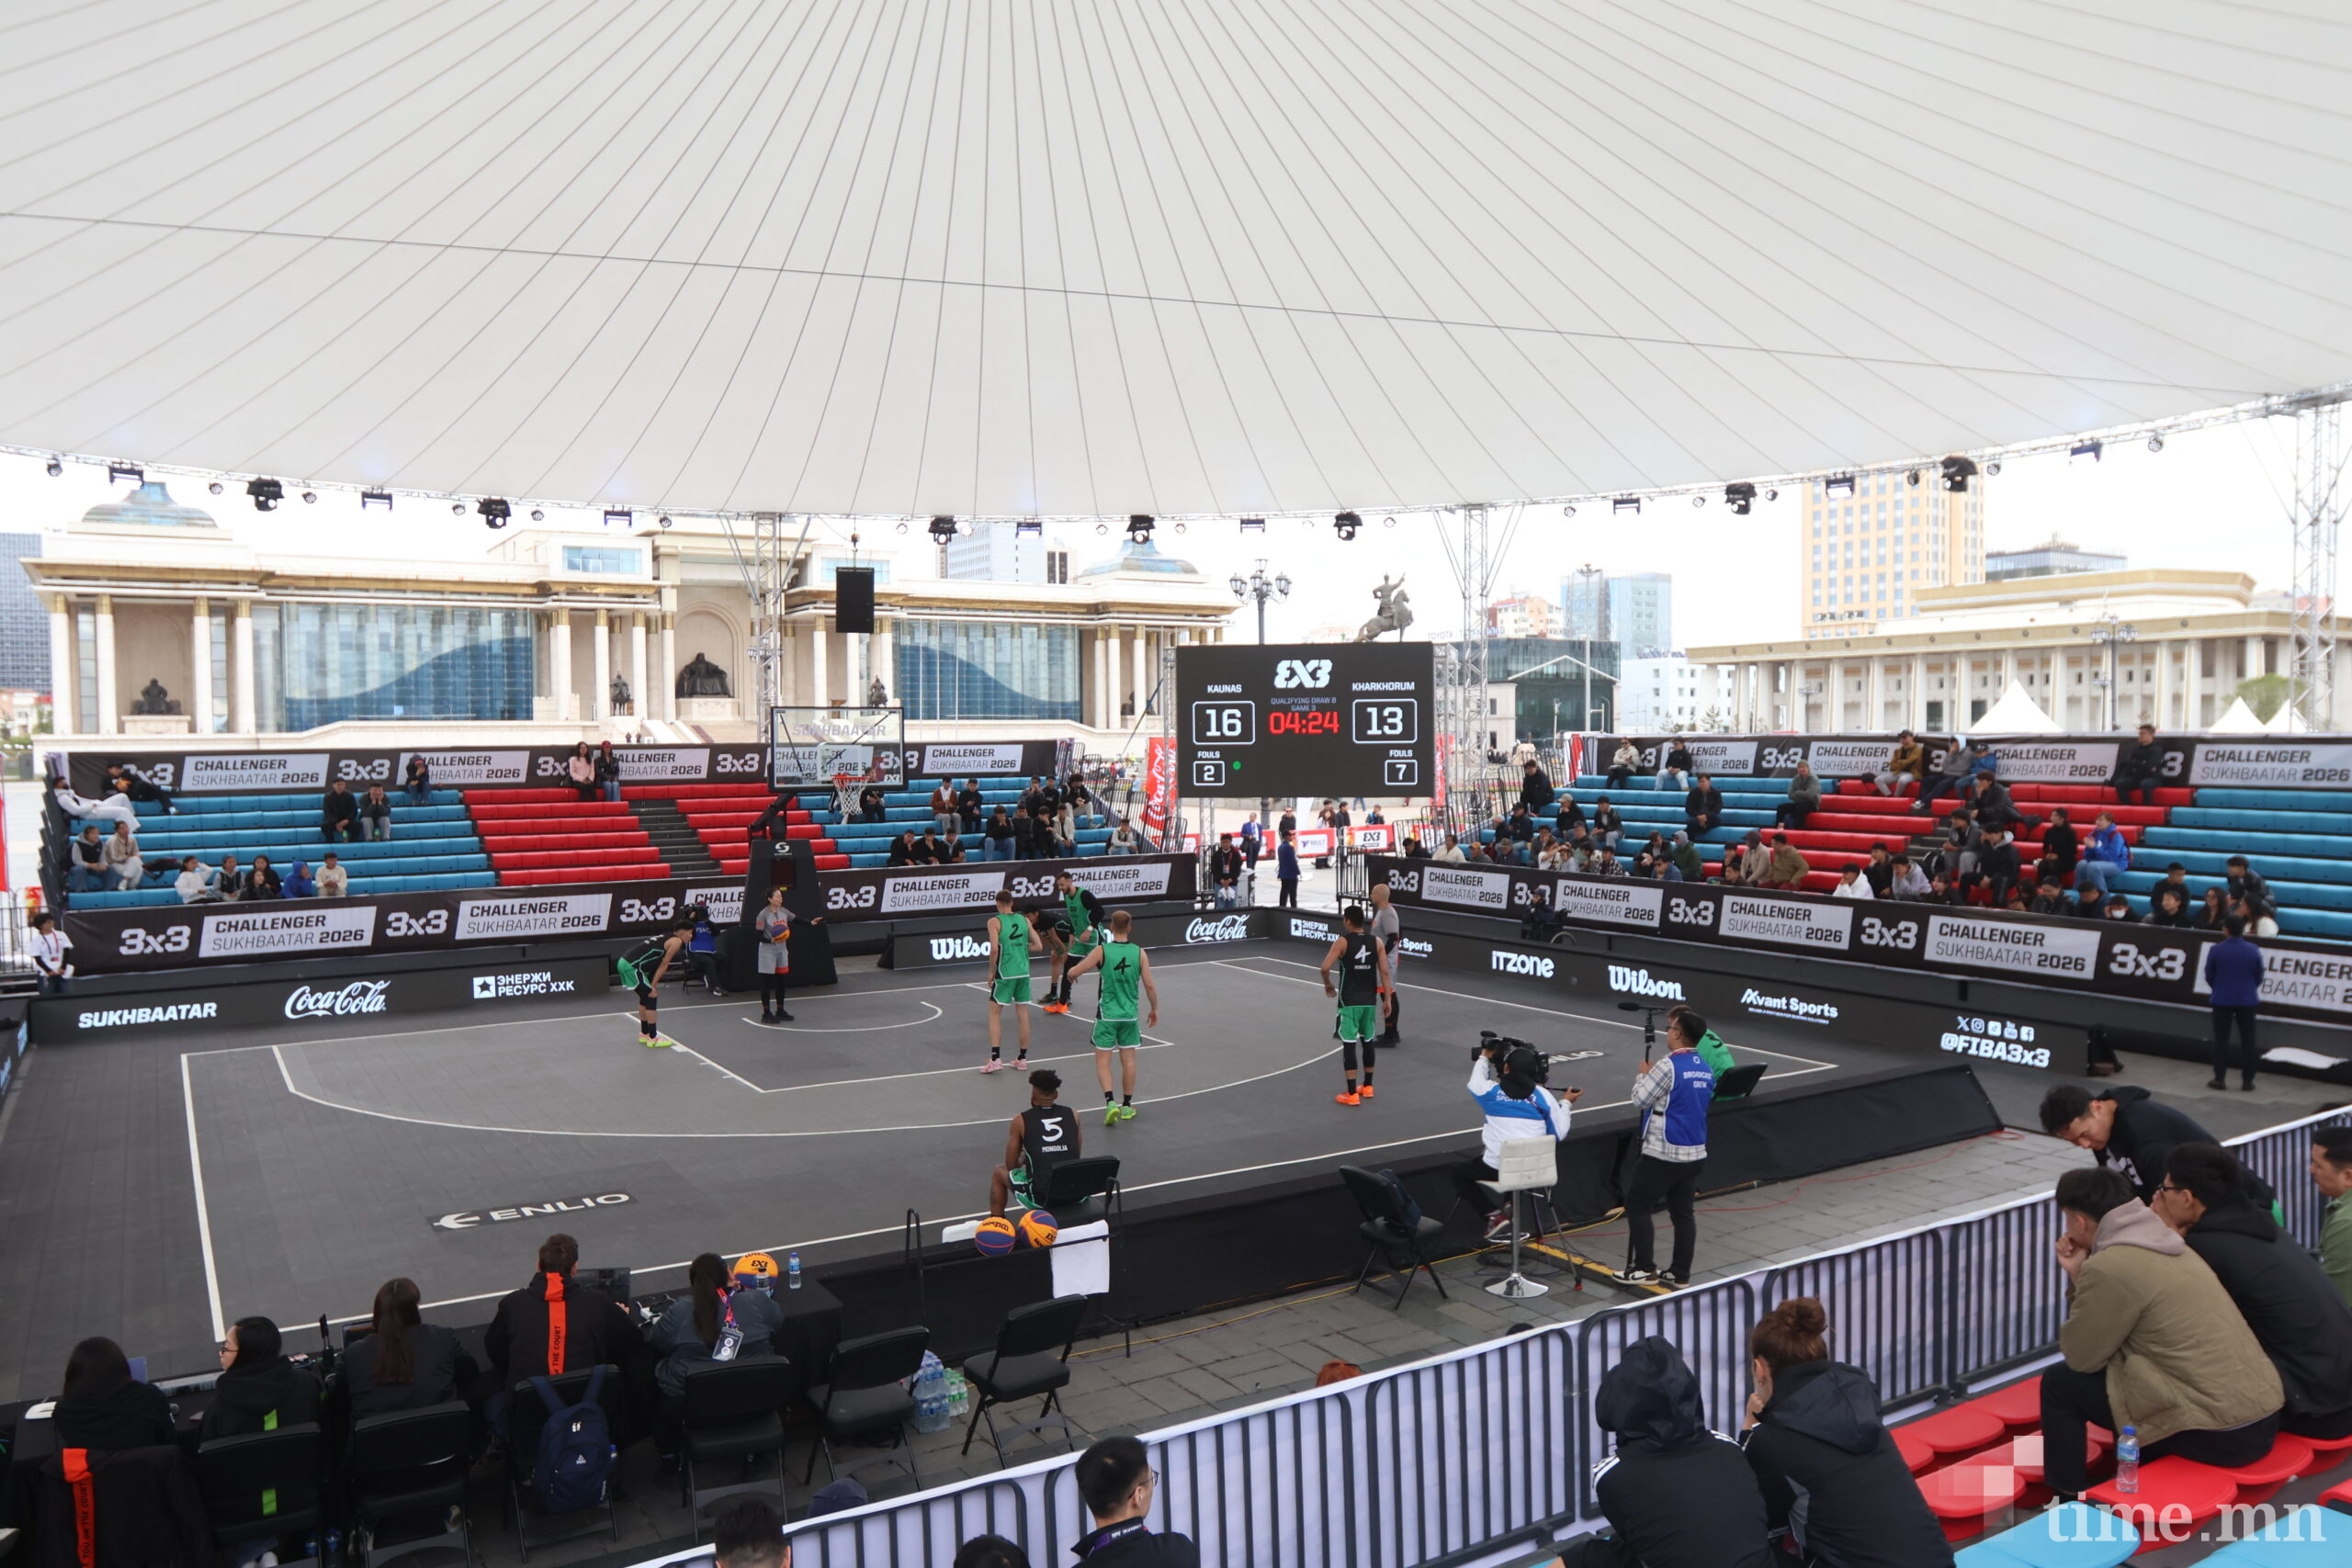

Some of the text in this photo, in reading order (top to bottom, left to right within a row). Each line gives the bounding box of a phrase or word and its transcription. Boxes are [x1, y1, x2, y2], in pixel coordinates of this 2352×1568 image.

[1207, 684, 1242, 694] KAUNAS
[1351, 682, 1415, 692] KHARKHORUM
[1205, 708, 1242, 736] 16
[1269, 711, 1340, 734] 04:24
[1366, 706, 1404, 735] 13
[424, 755, 492, 766] ALLENGER
[616, 752, 676, 763] ALLENGER
[932, 749, 995, 758] CHALLENGER
[1197, 750, 1220, 759] FOULS
[1389, 750, 1413, 758] FOULS
[1761, 747, 1804, 769] 3x3
[1816, 746, 1889, 758] CHALLENGER
[2204, 750, 2312, 763] CHALLENGER
[194, 759, 288, 772] CHALLENGER
[337, 759, 391, 781] 3x3
[537, 756, 570, 776] 3x
[620, 764, 703, 776] HBAATAR 2026
[716, 753, 760, 773] 3x3
[930, 760, 1017, 770] SUKHBAATAR 2026
[1722, 760, 1749, 770] 2026
[1813, 761, 1879, 773] SUKHBAATAR
[1997, 763, 2108, 777] UKHBAATAR 2026
[191, 773, 320, 786] SUKHBAATAR 2026
[429, 768, 521, 780] HBAATAR 2026
[1203, 765, 1216, 782] 2
[1396, 764, 1407, 781] 7
[2200, 766, 2351, 782] SUKHBAATAR 2026
[1071, 868, 1140, 882] CHALLENGER
[1388, 869, 1419, 892] 3x3
[1429, 872, 1484, 886] CHALLENGER
[892, 878, 970, 893] CHALLENGER
[1011, 875, 1057, 897] 3x3
[1134, 881, 1163, 892] 2026
[1563, 885, 1631, 903] CHALLENGER
[695, 890, 745, 904] CHALLE
[827, 886, 876, 910] 3x3
[889, 891, 997, 908] SUKHBAATAR 2026
[1428, 886, 1503, 904] SUKHBAATAR 2026
[469, 901, 568, 917] CHALLENGER
[620, 897, 676, 923] 3x3
[1561, 900, 1655, 921] SUKHBAATAR 2026
[1668, 897, 1715, 927] 3x3
[1730, 901, 1812, 921] CHALLENGER
[215, 915, 326, 933] CHALLENGER
[385, 909, 448, 938] 3x3
[467, 915, 601, 934] SUKHBAATAR 2026
[1009, 923, 1023, 940] 2
[1185, 914, 1250, 943] Coca-Cola
[1302, 919, 1329, 932] ЭНЕРЖИ
[1727, 918, 1843, 943] SUKHBAATAR 2026
[119, 925, 191, 955] 3x3
[212, 930, 365, 952] SUKHBAATAR 2026
[1302, 929, 1326, 942] РЕСУРС
[1860, 917, 1918, 950] 3x3
[1939, 922, 2045, 947] CHALLENGER
[930, 935, 991, 961] Wilso
[1354, 944, 1372, 964] 4
[1403, 938, 1433, 953] Sports
[1113, 956, 1132, 976] 4
[1935, 942, 2086, 972] SUKHBAATAR 2026
[2109, 942, 2187, 981] 3x3
[2266, 955, 2352, 981] LENGER
[497, 972, 551, 986] ЭНЕРЖИ
[1607, 964, 1686, 1001] Wilson
[498, 980, 575, 997] РЕСУРС ХХК
[2261, 977, 2336, 1002] BAATAR
[284, 980, 390, 1020] Coca-Cola
[1789, 998, 1838, 1019] Sports
[78, 1002, 218, 1029] SUKHBAATAR
[1548, 1050, 1604, 1065] NLIO
[1940, 1032, 2051, 1068] @FIBA3x3
[1041, 1117, 1064, 1143] 5
[1042, 1145, 1069, 1153] MONGOLIA
[489, 1193, 630, 1221] ENLIO
[552, 1325, 561, 1367] THE COURT
[81, 1511, 89, 1525] THE
